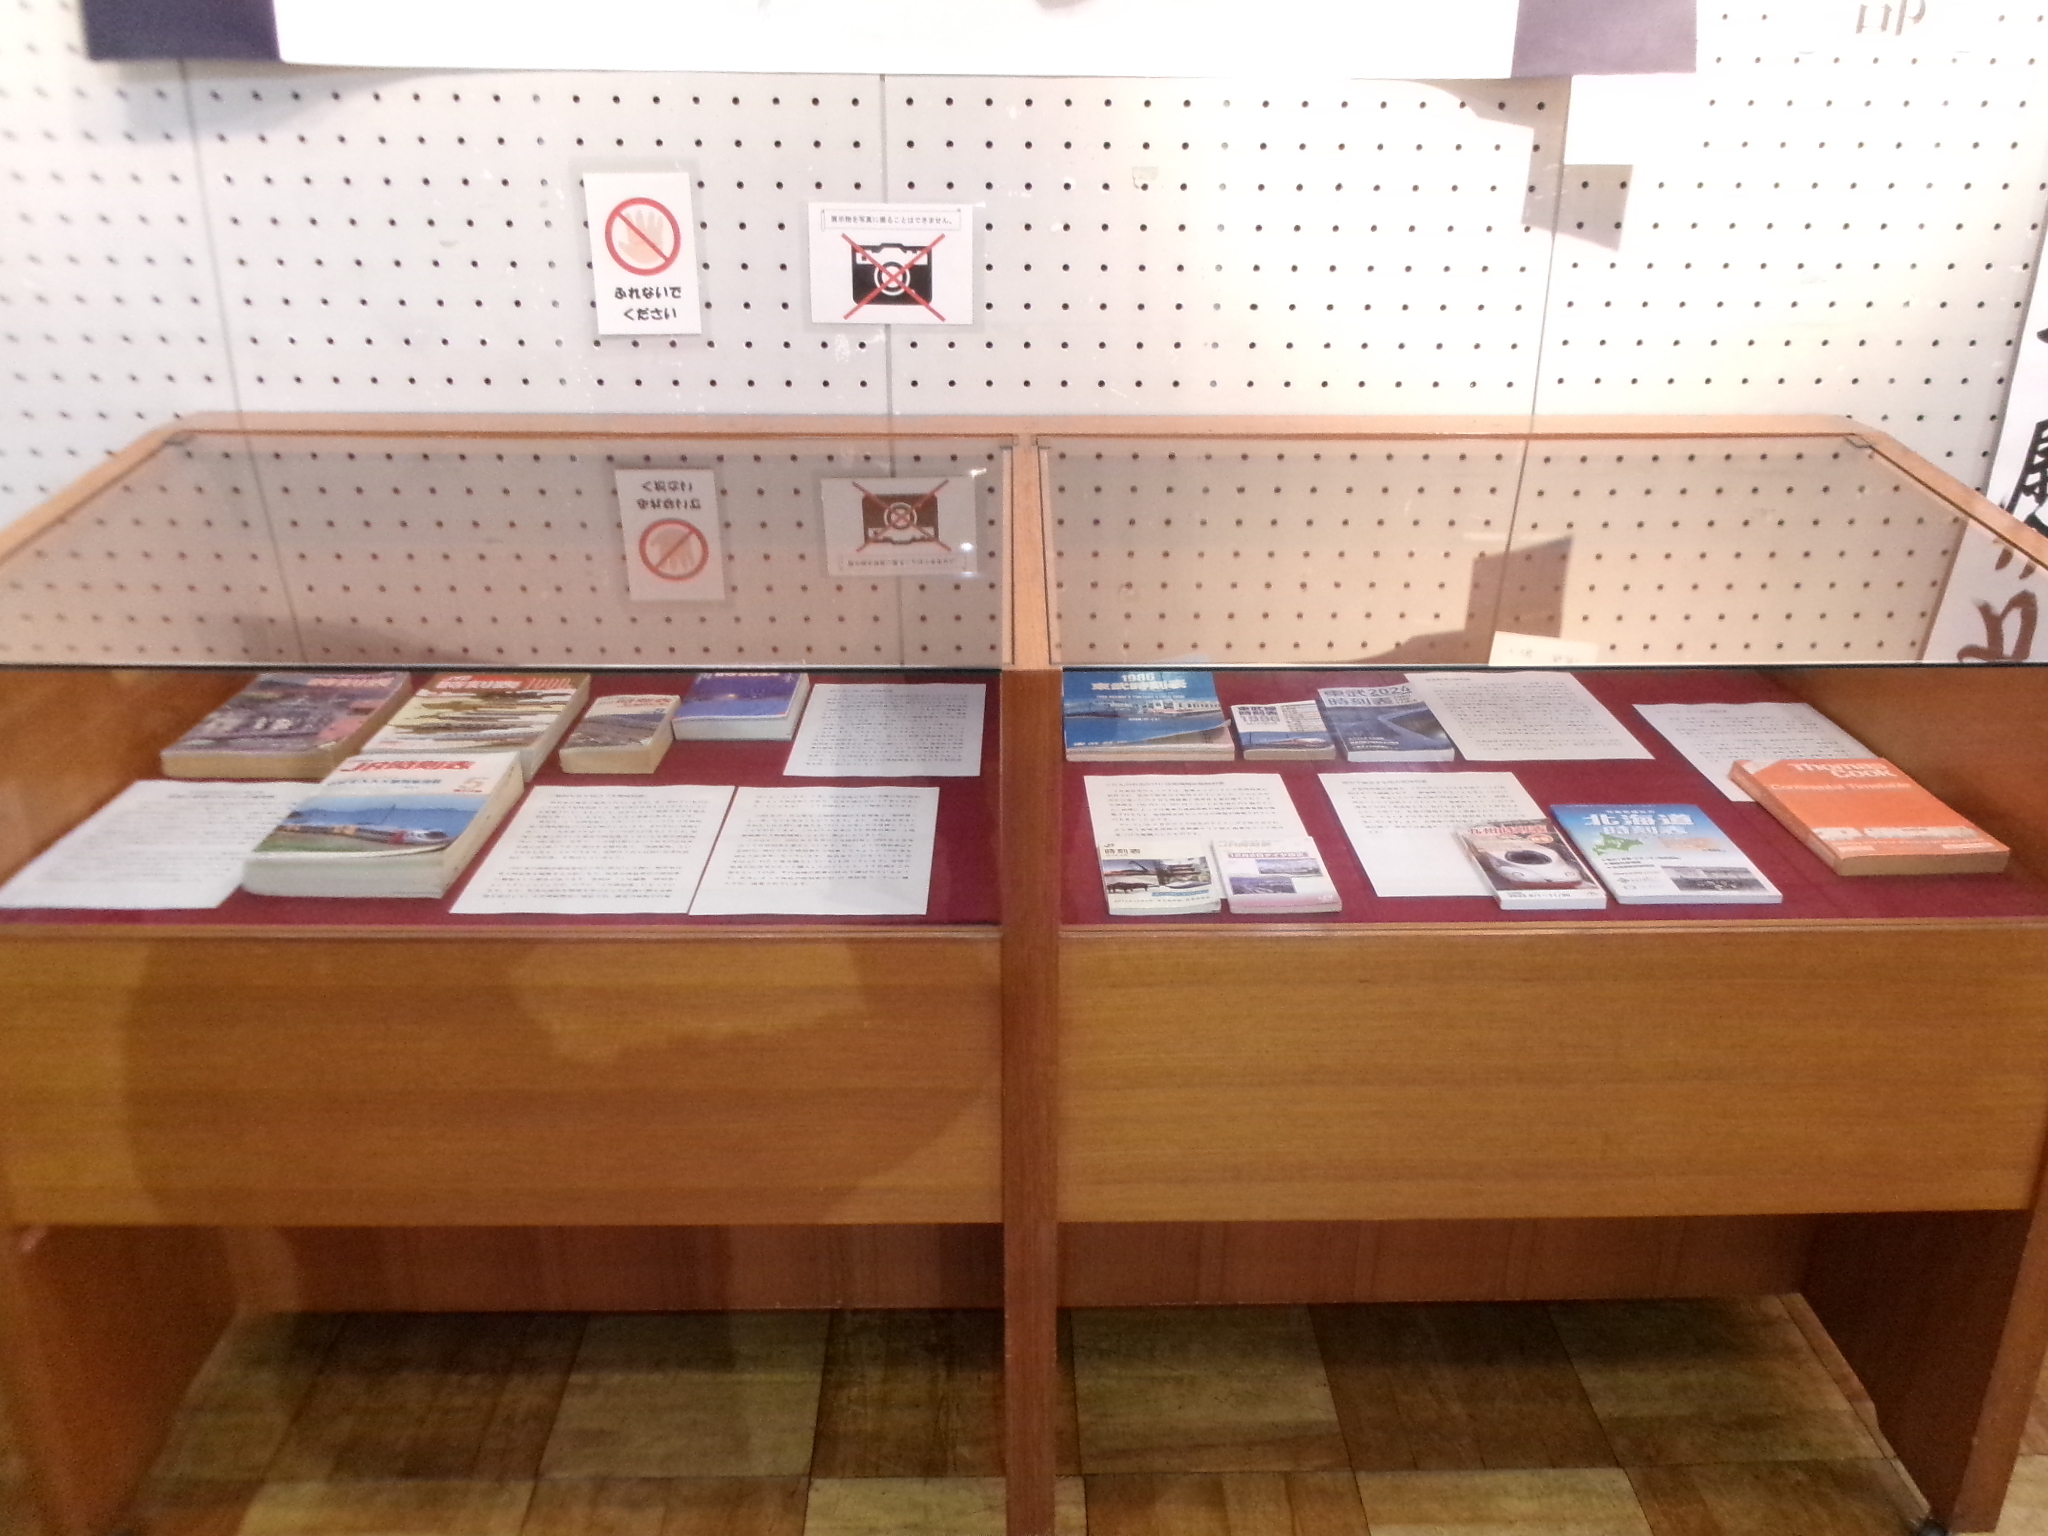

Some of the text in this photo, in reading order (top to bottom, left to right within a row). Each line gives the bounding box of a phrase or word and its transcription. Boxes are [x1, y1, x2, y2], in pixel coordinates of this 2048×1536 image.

[614, 286, 682, 300] ふれないで
[623, 307, 678, 321] ください
[1788, 762, 1888, 773] Thomas
[1831, 768, 1898, 779] Cook
[1582, 813, 1695, 826] 北海道
[1602, 825, 1688, 835] 時刻表
